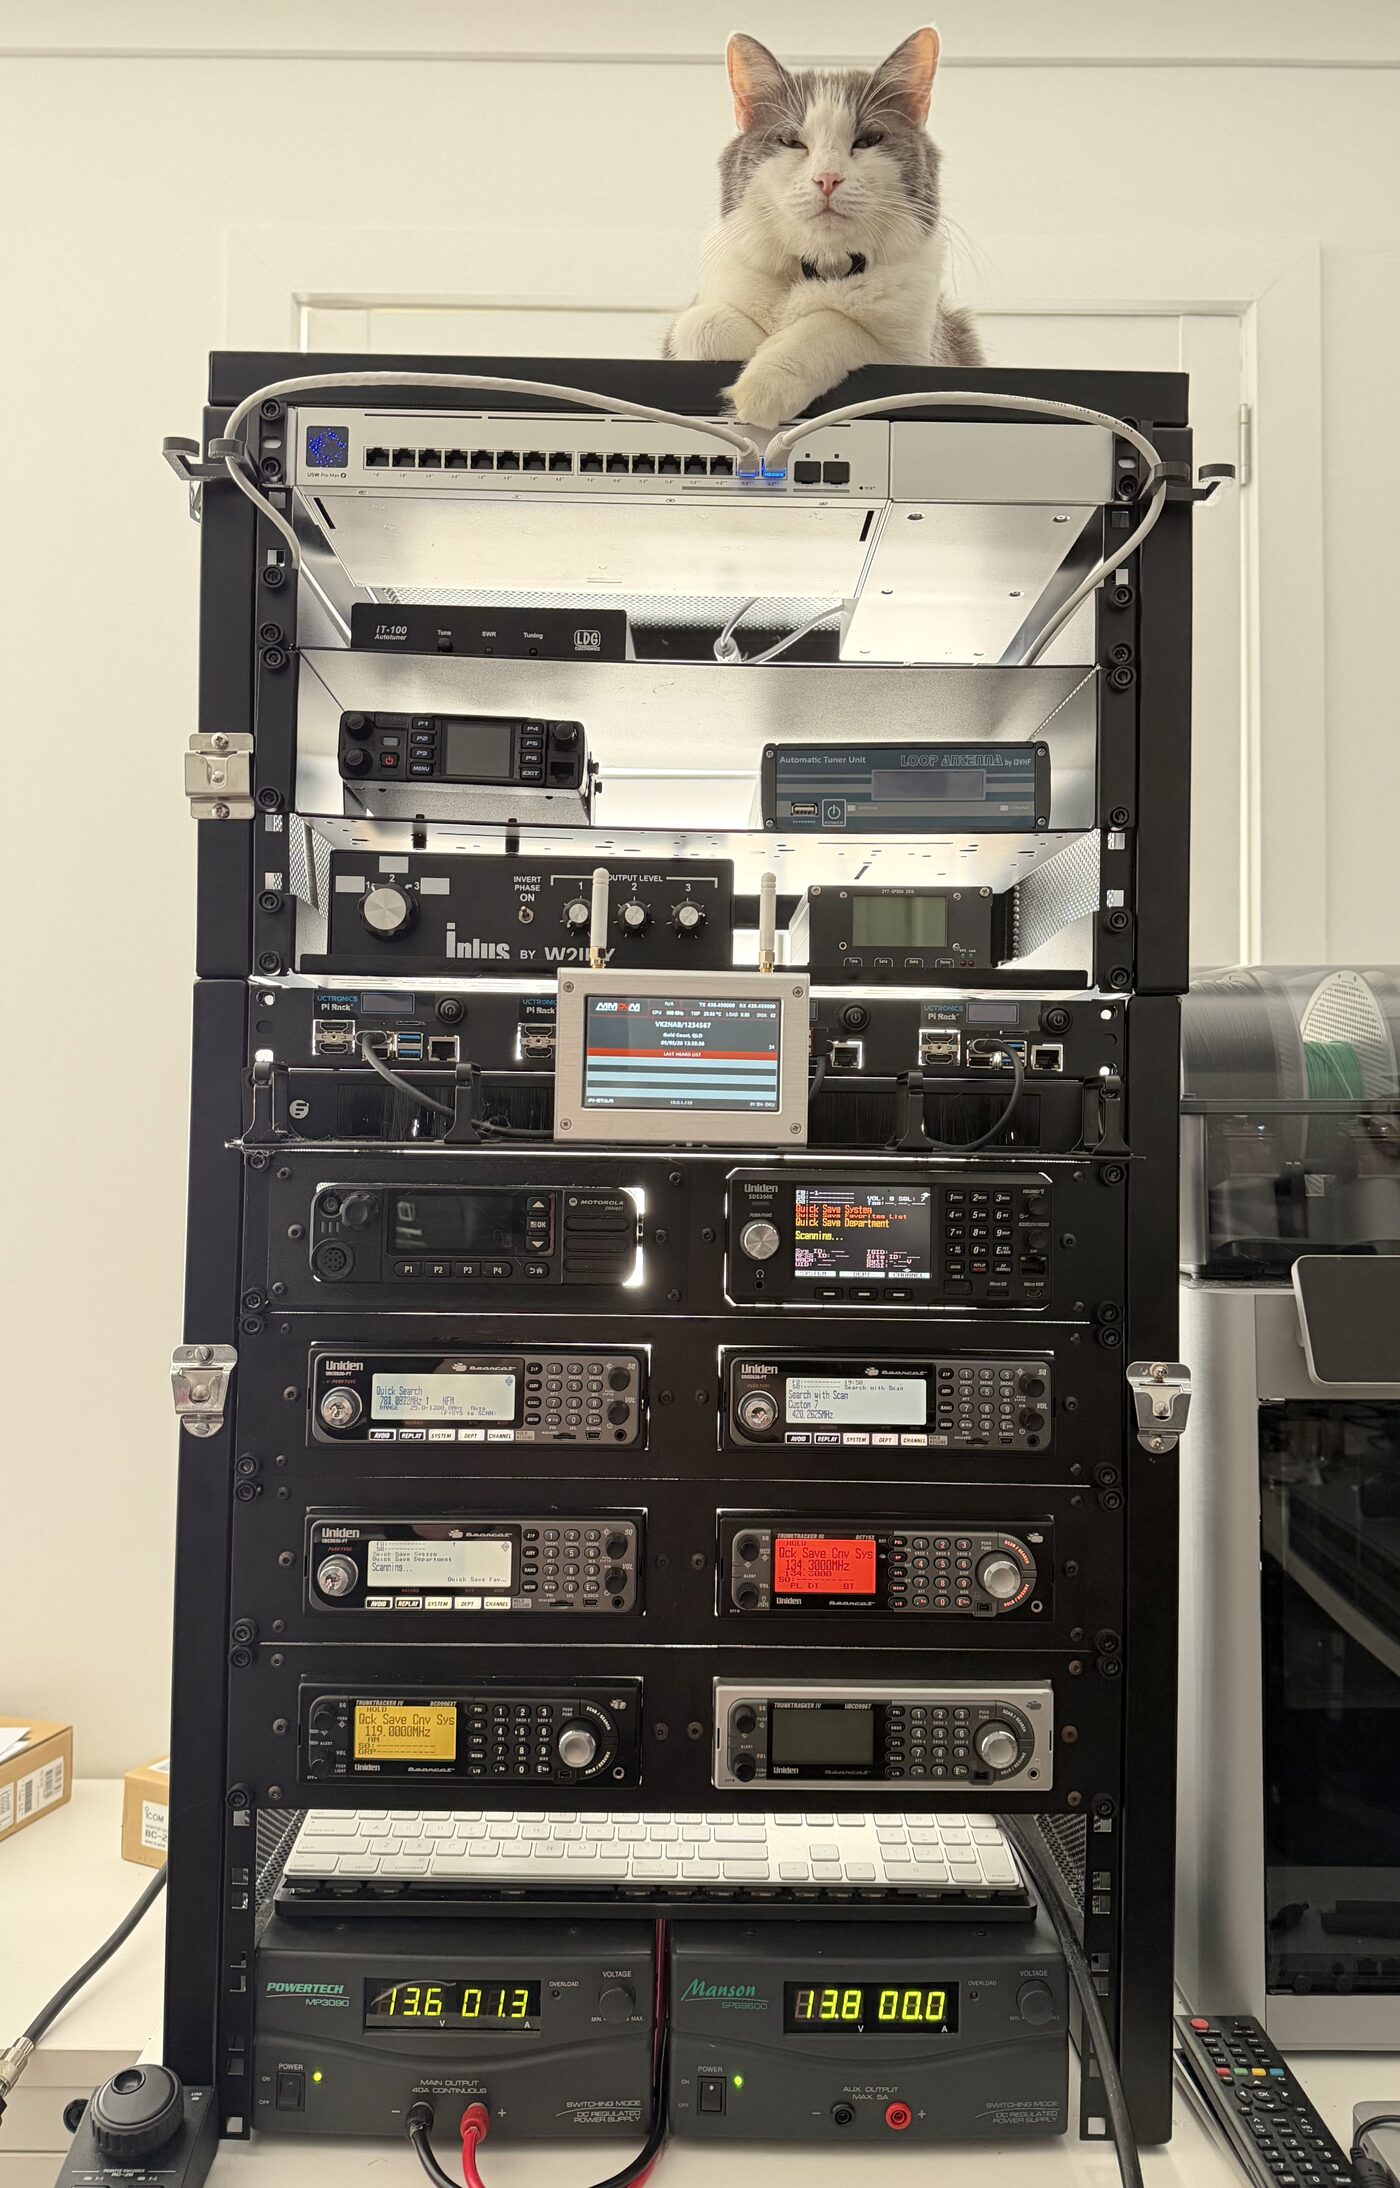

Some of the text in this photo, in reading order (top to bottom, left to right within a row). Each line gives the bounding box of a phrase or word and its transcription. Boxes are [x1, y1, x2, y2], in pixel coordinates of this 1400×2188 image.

[376, 625, 408, 635] IT-100
[523, 632, 544, 640] Tuning
[576, 632, 599, 645] LDG
[779, 756, 867, 764] Automatic Tuner Unit
[900, 754, 939, 767] LOOP
[940, 754, 1004, 767] ANTENNA
[1004, 759, 1012, 768] by
[522, 769, 539, 777] EXIT
[389, 874, 396, 883] 2
[513, 875, 542, 883] INVERT
[639, 875, 664, 883] LEVEL
[414, 882, 420, 890] 3
[514, 884, 541, 892] PHASE
[631, 883, 638, 891] 2
[685, 883, 692, 892] 3
[519, 893, 535, 903] ON
[520, 950, 537, 960] BY
[321, 1003, 351, 1011] Pi Rack
[526, 1006, 535, 1014] Pi
[923, 1004, 964, 1012] UCTRONICS
[928, 1012, 957, 1022] Pi Rack
[744, 1183, 779, 1193] Uniden
[795, 1204, 873, 1215] Quick Save System
[795, 1217, 890, 1228] Quick Save Department
[795, 1230, 844, 1241] Scanning...
[404, 1265, 413, 1274] P1
[433, 1266, 443, 1275] P2
[463, 1266, 473, 1275] P3
[493, 1266, 502, 1275] P4
[325, 1360, 364, 1371] Uniden
[741, 1363, 779, 1374] Uniden
[376, 1386, 423, 1396] Quick Search
[788, 1390, 849, 1400] Search with Scan
[788, 1400, 819, 1409] Custom 7
[792, 1409, 834, 1420] 420.2625MHz
[373, 1431, 391, 1439] AVOID
[401, 1432, 423, 1440] REPLAY
[790, 1435, 807, 1443] AVOID
[321, 1527, 360, 1538] Uniden
[779, 1547, 874, 1560] Qck Save Cnv Sys
[371, 1562, 413, 1573] Scanning...
[785, 1559, 850, 1572] 134.3000MHz
[370, 1600, 387, 1608] AVOID
[776, 1597, 802, 1605] Uniden
[358, 1713, 455, 1726] Qck Save Cnv Sys
[365, 1725, 431, 1738] 119.0000MHz
[354, 1763, 381, 1771] Uniden
[773, 1766, 799, 1775] Uniden
[602, 1970, 632, 1978] VOLTAGE
[1019, 1969, 1049, 1977] VOLTAGE
[266, 1982, 345, 1994] POWERTECH
[680, 1978, 756, 2001] Manson
[305, 1998, 350, 2007] MP3090
[389, 1987, 443, 2017] 13.6
[806, 1989, 862, 2020] 13.8
[878, 1990, 946, 2021] 00.0
[524, 2021, 531, 2029] A
[857, 2025, 865, 2033] V
[941, 2025, 948, 2033] A
[278, 2062, 304, 2071] POWER
[444, 2079, 479, 2087] OUTPUT
[566, 2100, 614, 2108] SWITCHING
[986, 2101, 1033, 2109] SWITCHING
[1009, 2110, 1058, 2118] REGULATED
